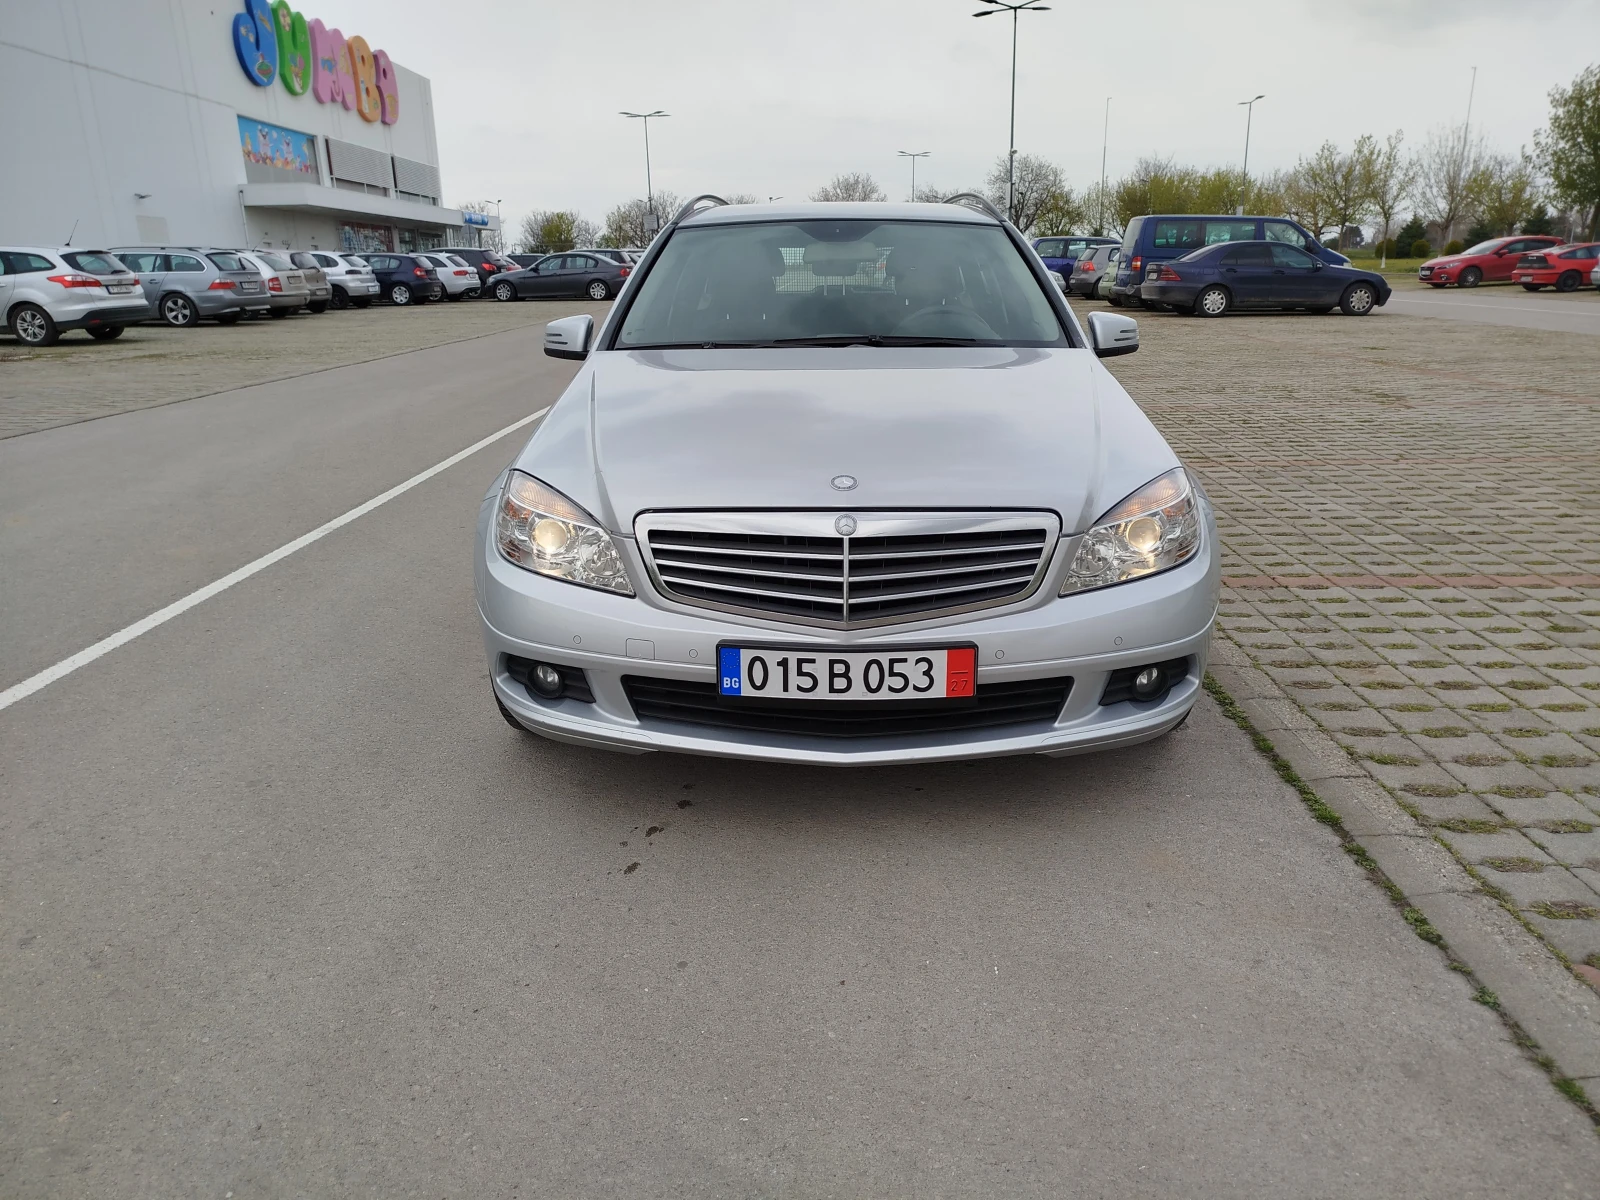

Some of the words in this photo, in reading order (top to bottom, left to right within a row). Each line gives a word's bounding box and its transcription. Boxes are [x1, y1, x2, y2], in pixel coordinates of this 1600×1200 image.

[232, 0, 399, 125] JUMBO
[723, 677, 740, 689] BG
[950, 679, 969, 692] 27
